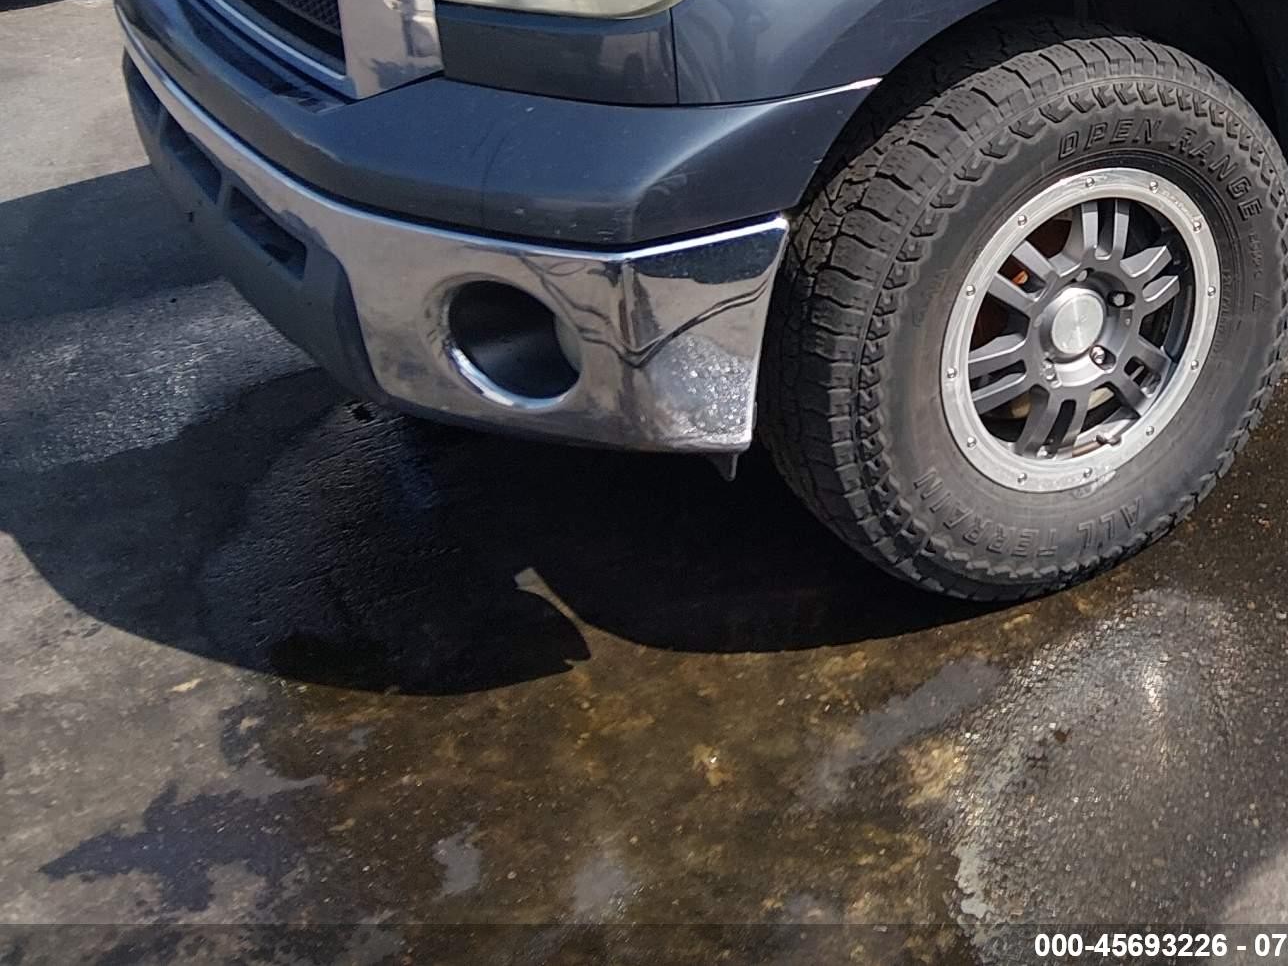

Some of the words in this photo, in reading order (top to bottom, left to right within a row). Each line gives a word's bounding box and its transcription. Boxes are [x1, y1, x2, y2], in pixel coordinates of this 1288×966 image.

[1058, 118, 1162, 161] OPEN
[1168, 127, 1263, 222] RANGE
[913, 467, 1058, 558] TERRAIN
[1078, 495, 1143, 554] ALL
